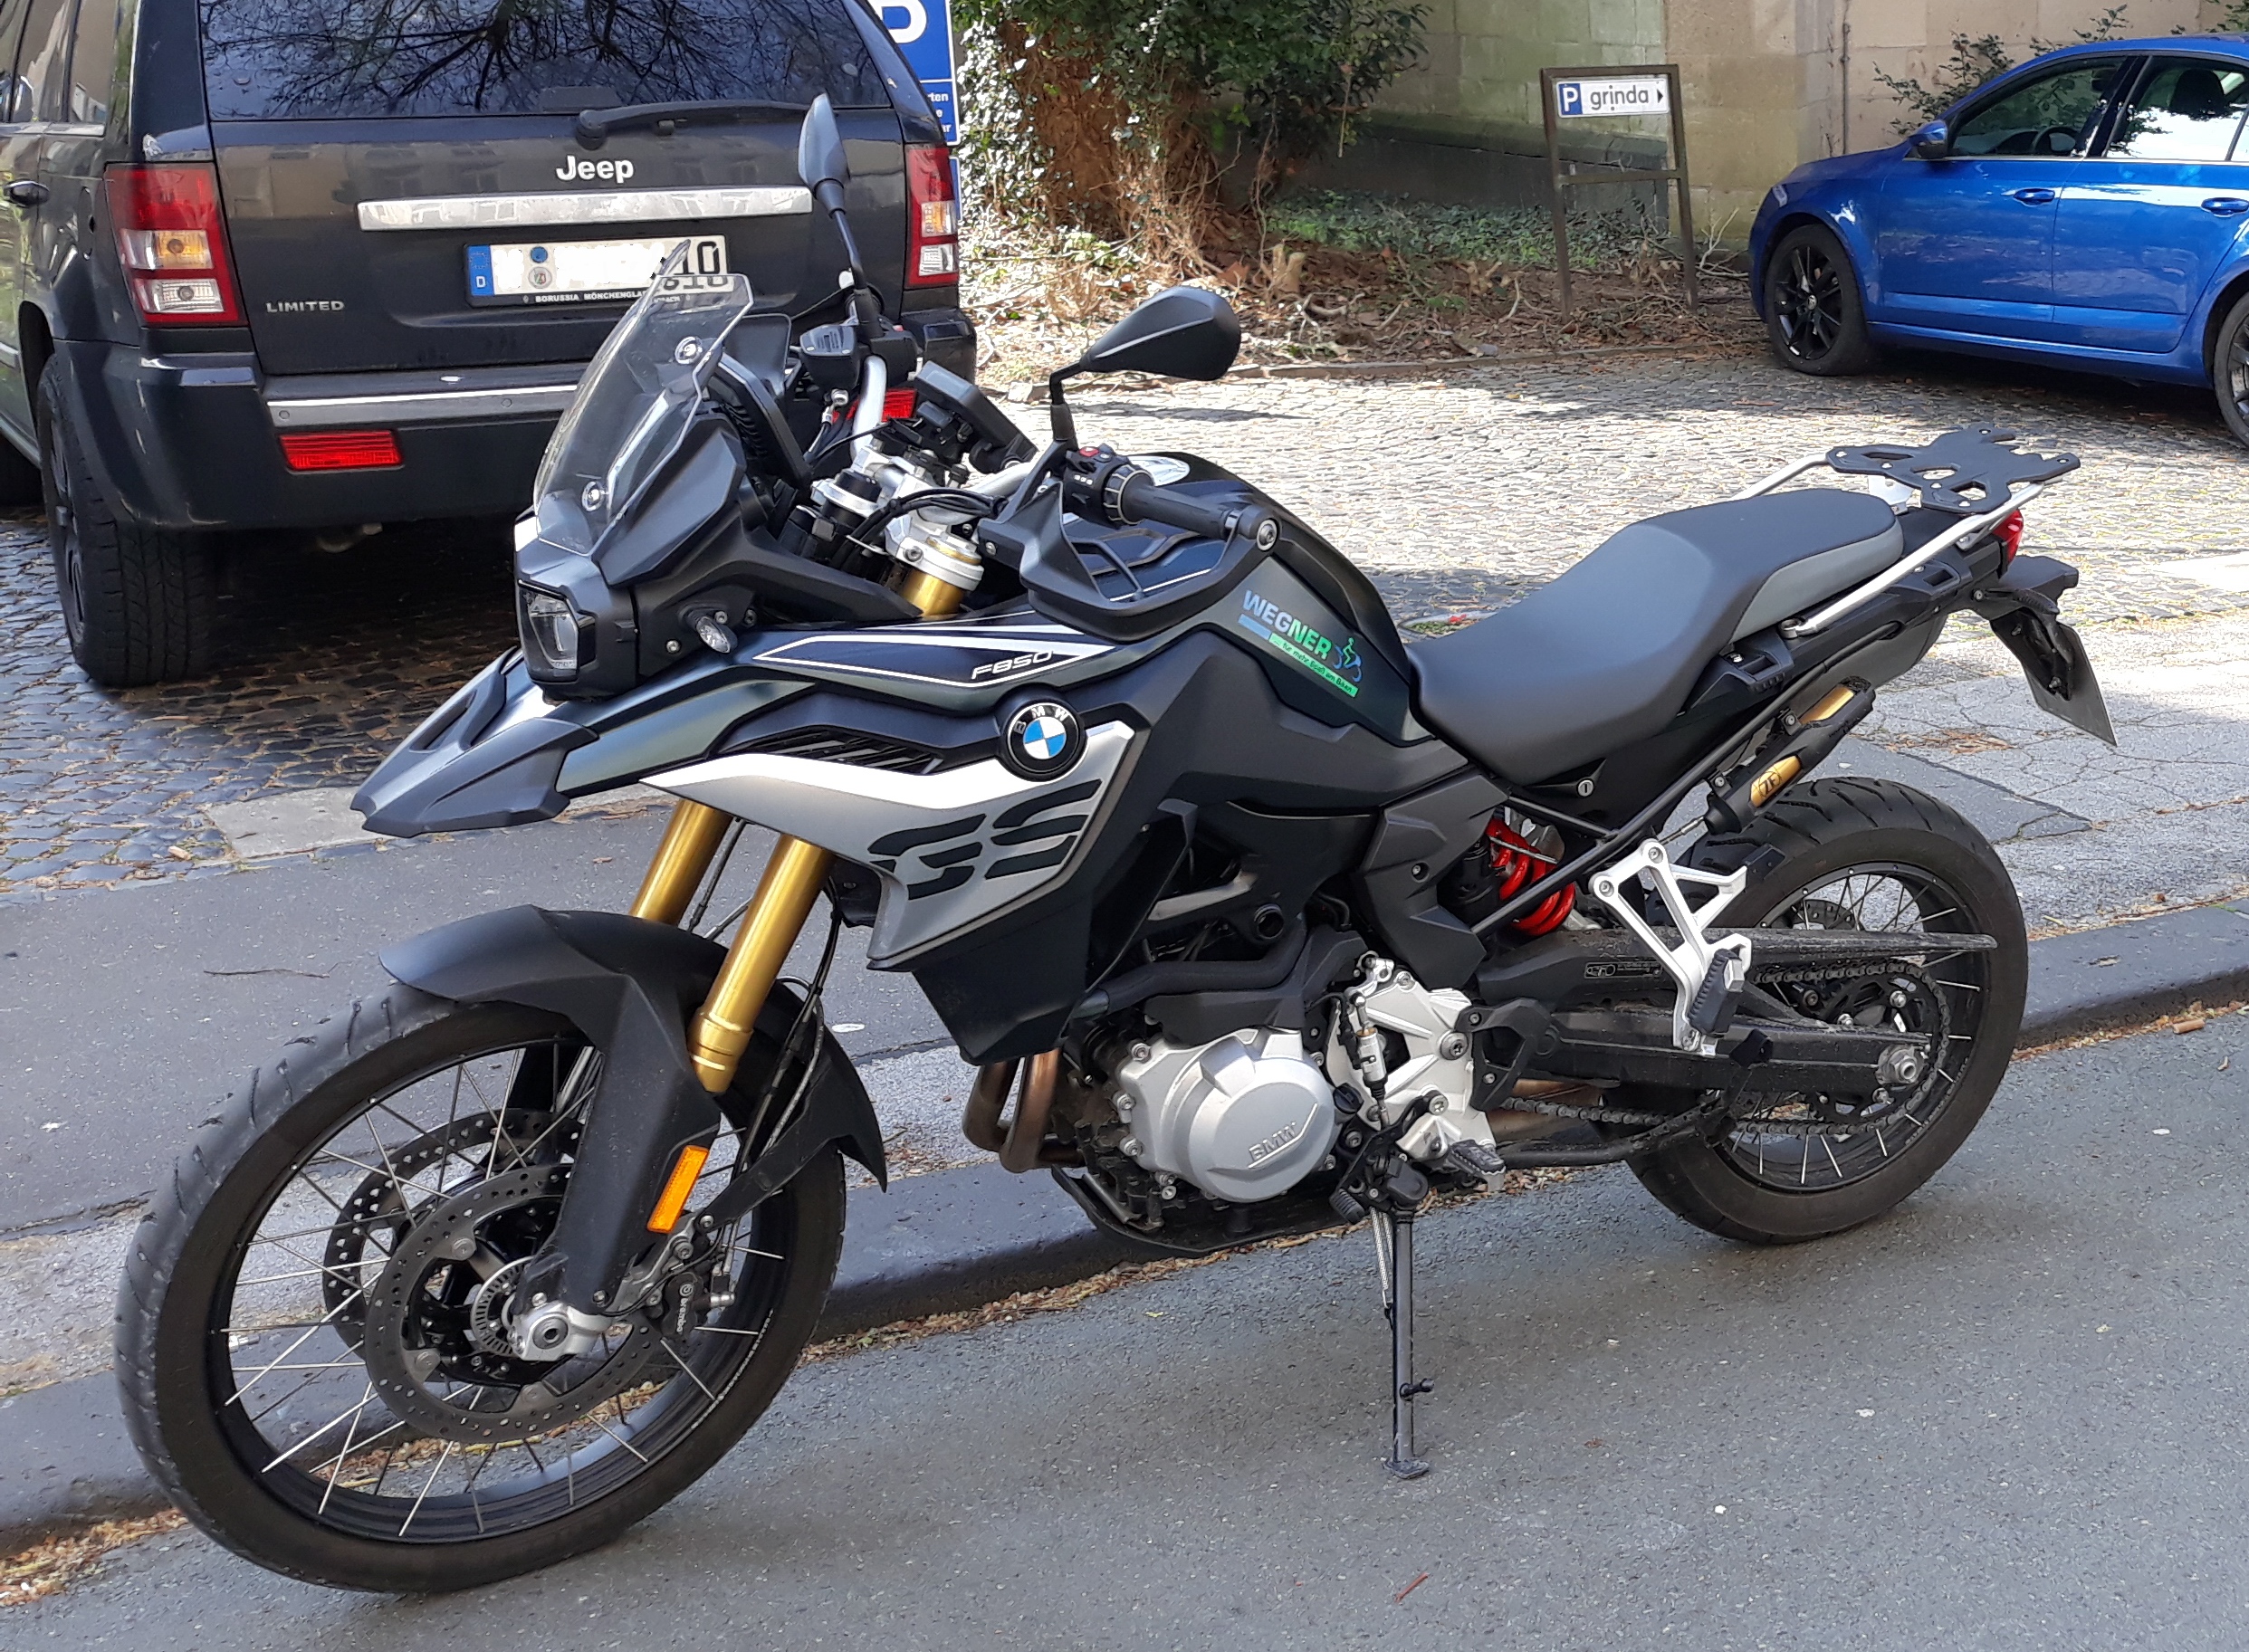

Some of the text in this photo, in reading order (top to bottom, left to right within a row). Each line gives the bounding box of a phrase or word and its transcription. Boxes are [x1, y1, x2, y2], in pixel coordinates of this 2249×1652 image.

[1563, 87, 1578, 112] P
[556, 155, 634, 184] Jeep
[475, 274, 486, 288] D
[266, 301, 344, 313] LIMITED
[535, 294, 579, 303] BORUSSIA
[1242, 590, 1332, 660] WEGNER
[971, 651, 1054, 680] F850
[1014, 705, 1067, 735] BMW
[867, 778, 1103, 901] GS
[1249, 1122, 1296, 1162] BMW
